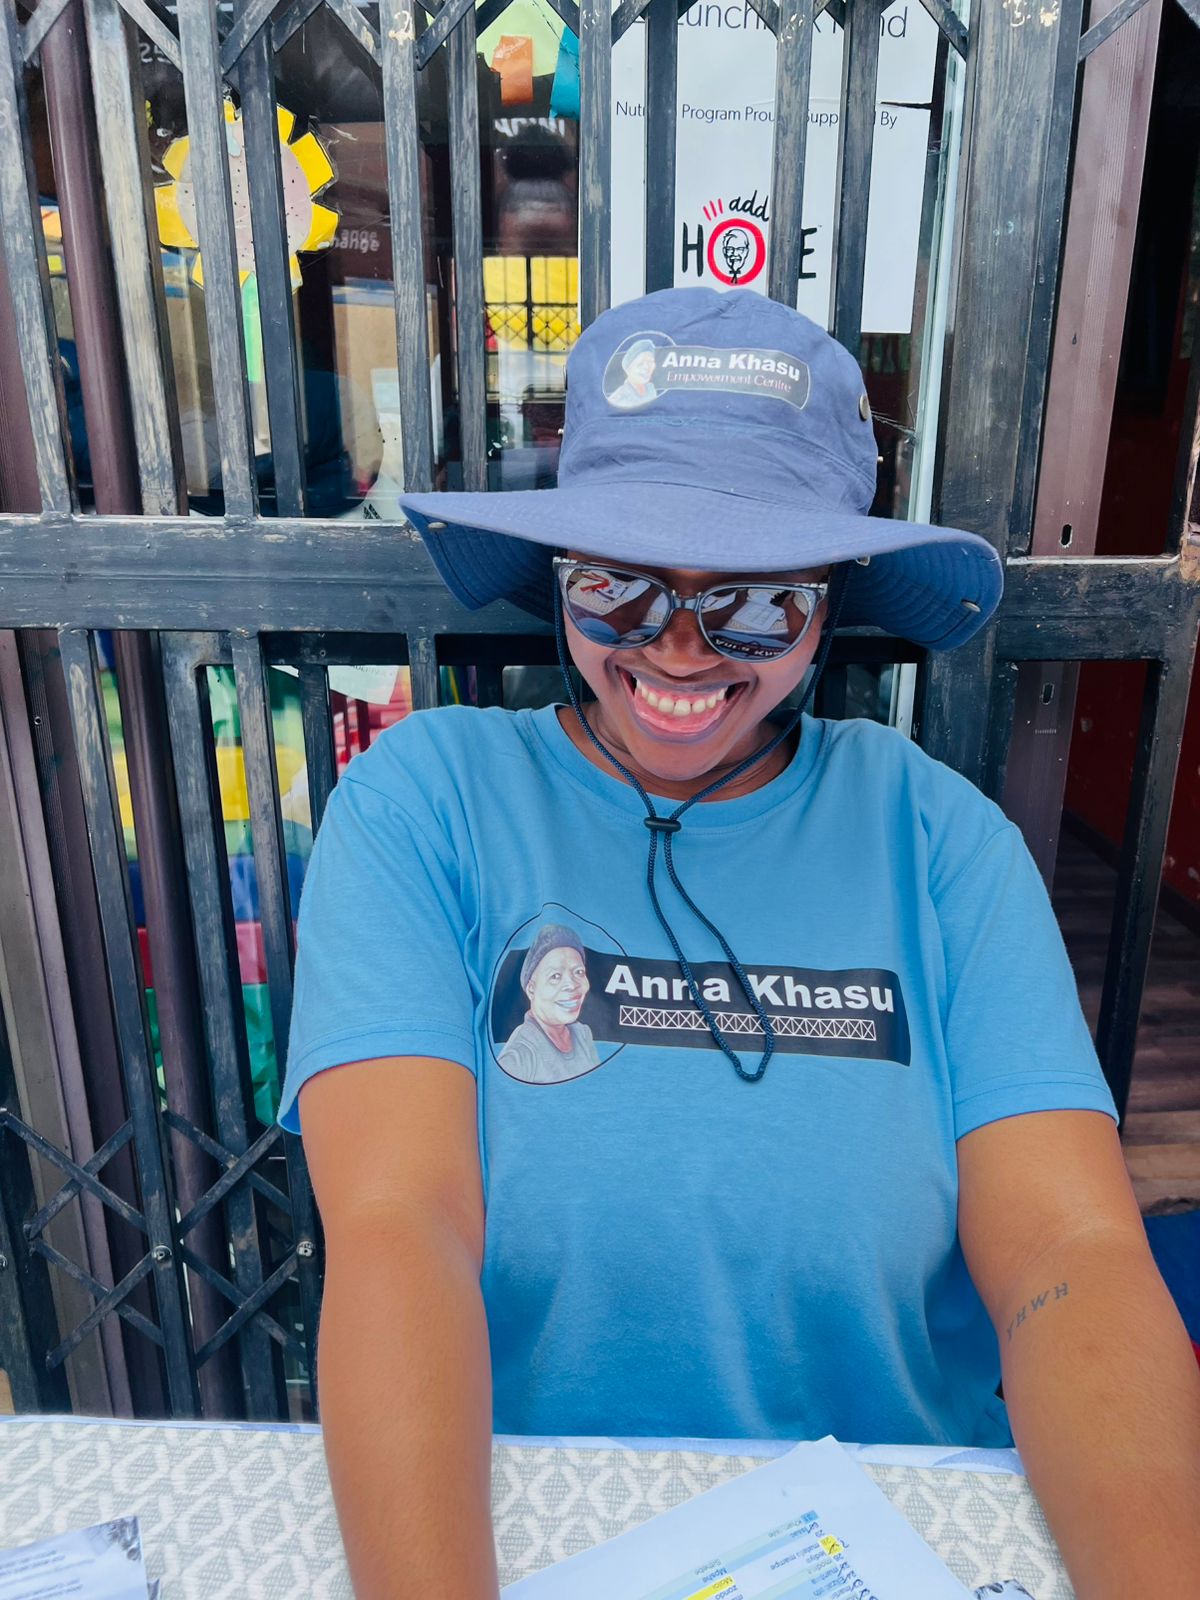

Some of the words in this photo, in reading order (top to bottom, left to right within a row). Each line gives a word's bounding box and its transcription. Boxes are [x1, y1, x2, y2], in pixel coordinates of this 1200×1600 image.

[682, 104, 741, 123] Program
[745, 106, 776, 122] Prou
[880, 111, 897, 129] By
[729, 190, 769, 222] add
[682, 218, 817, 286] HOE
[662, 351, 721, 369] Anna
[729, 353, 800, 382] Khasu
[604, 964, 731, 1002] Anna
[747, 974, 894, 1013] Khasu
